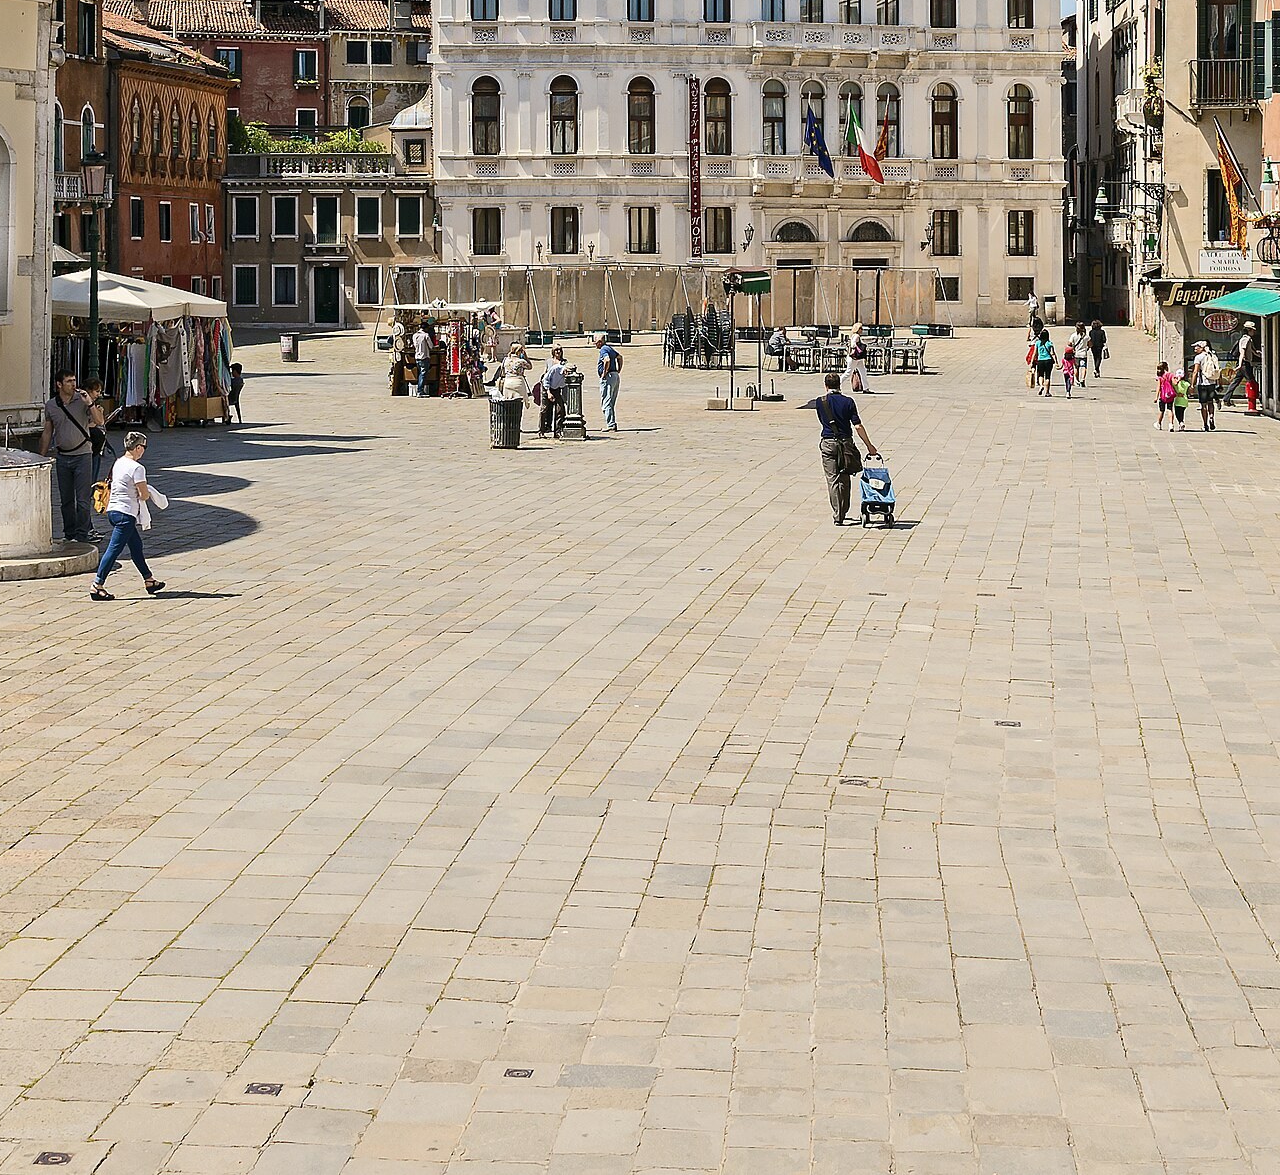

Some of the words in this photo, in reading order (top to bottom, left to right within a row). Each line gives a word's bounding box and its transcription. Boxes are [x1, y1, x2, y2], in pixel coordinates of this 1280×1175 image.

[690, 82, 699, 135] RUZZINI
[691, 138, 699, 183] PALACE
[691, 216, 701, 258] HOTE
